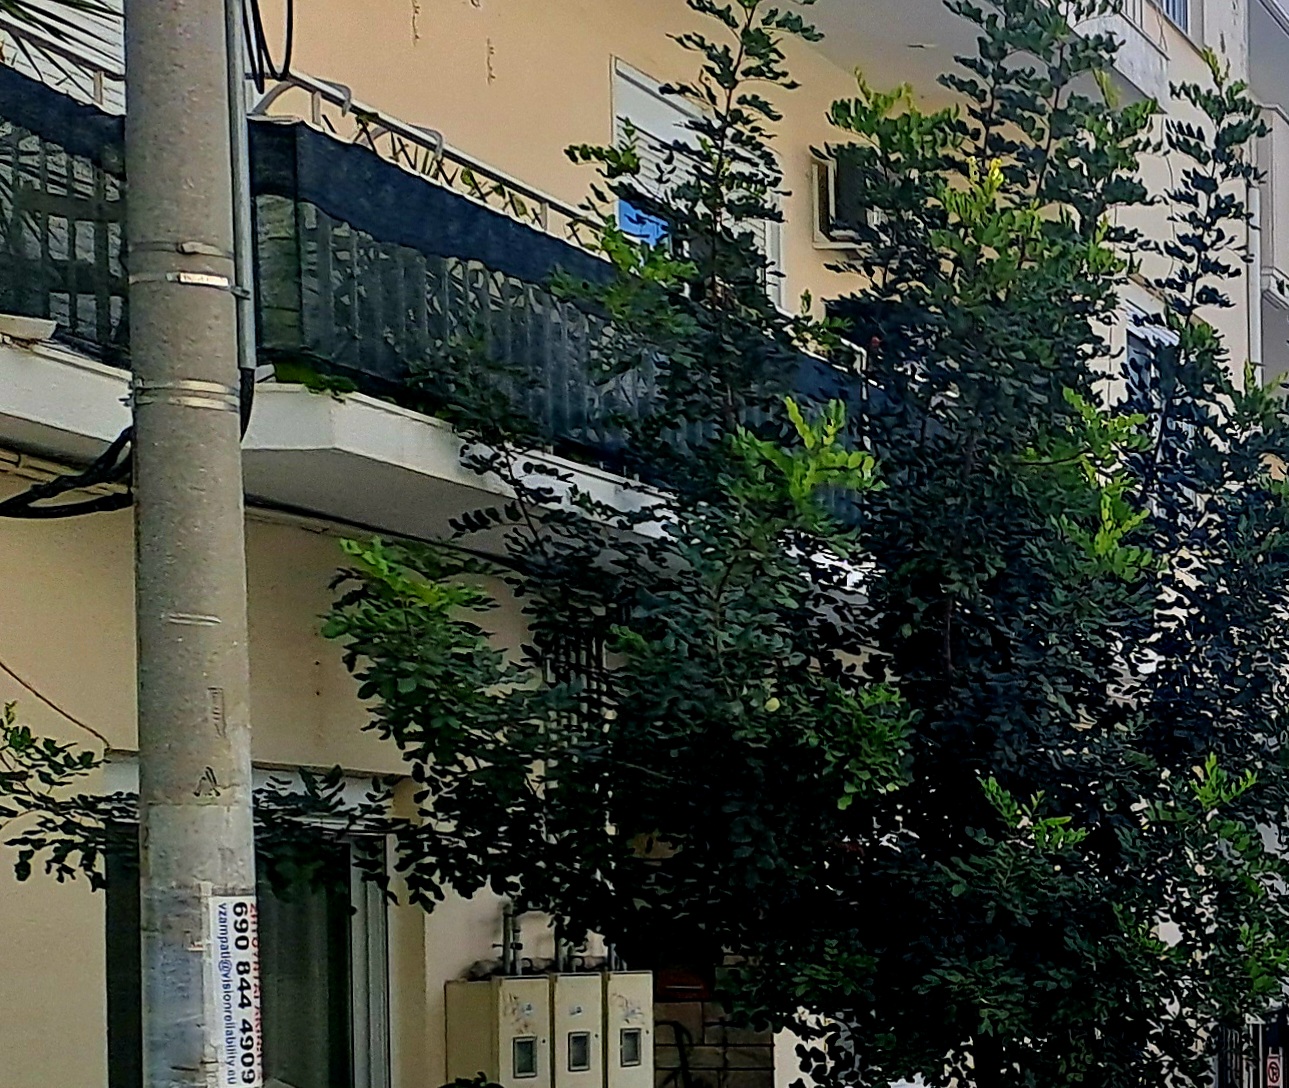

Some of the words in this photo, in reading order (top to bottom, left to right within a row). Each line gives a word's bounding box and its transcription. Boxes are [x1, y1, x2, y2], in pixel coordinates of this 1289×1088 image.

[232, 901, 250, 951] 690
[236, 960, 252, 1010] 844
[238, 1019, 256, 1085] 4909
